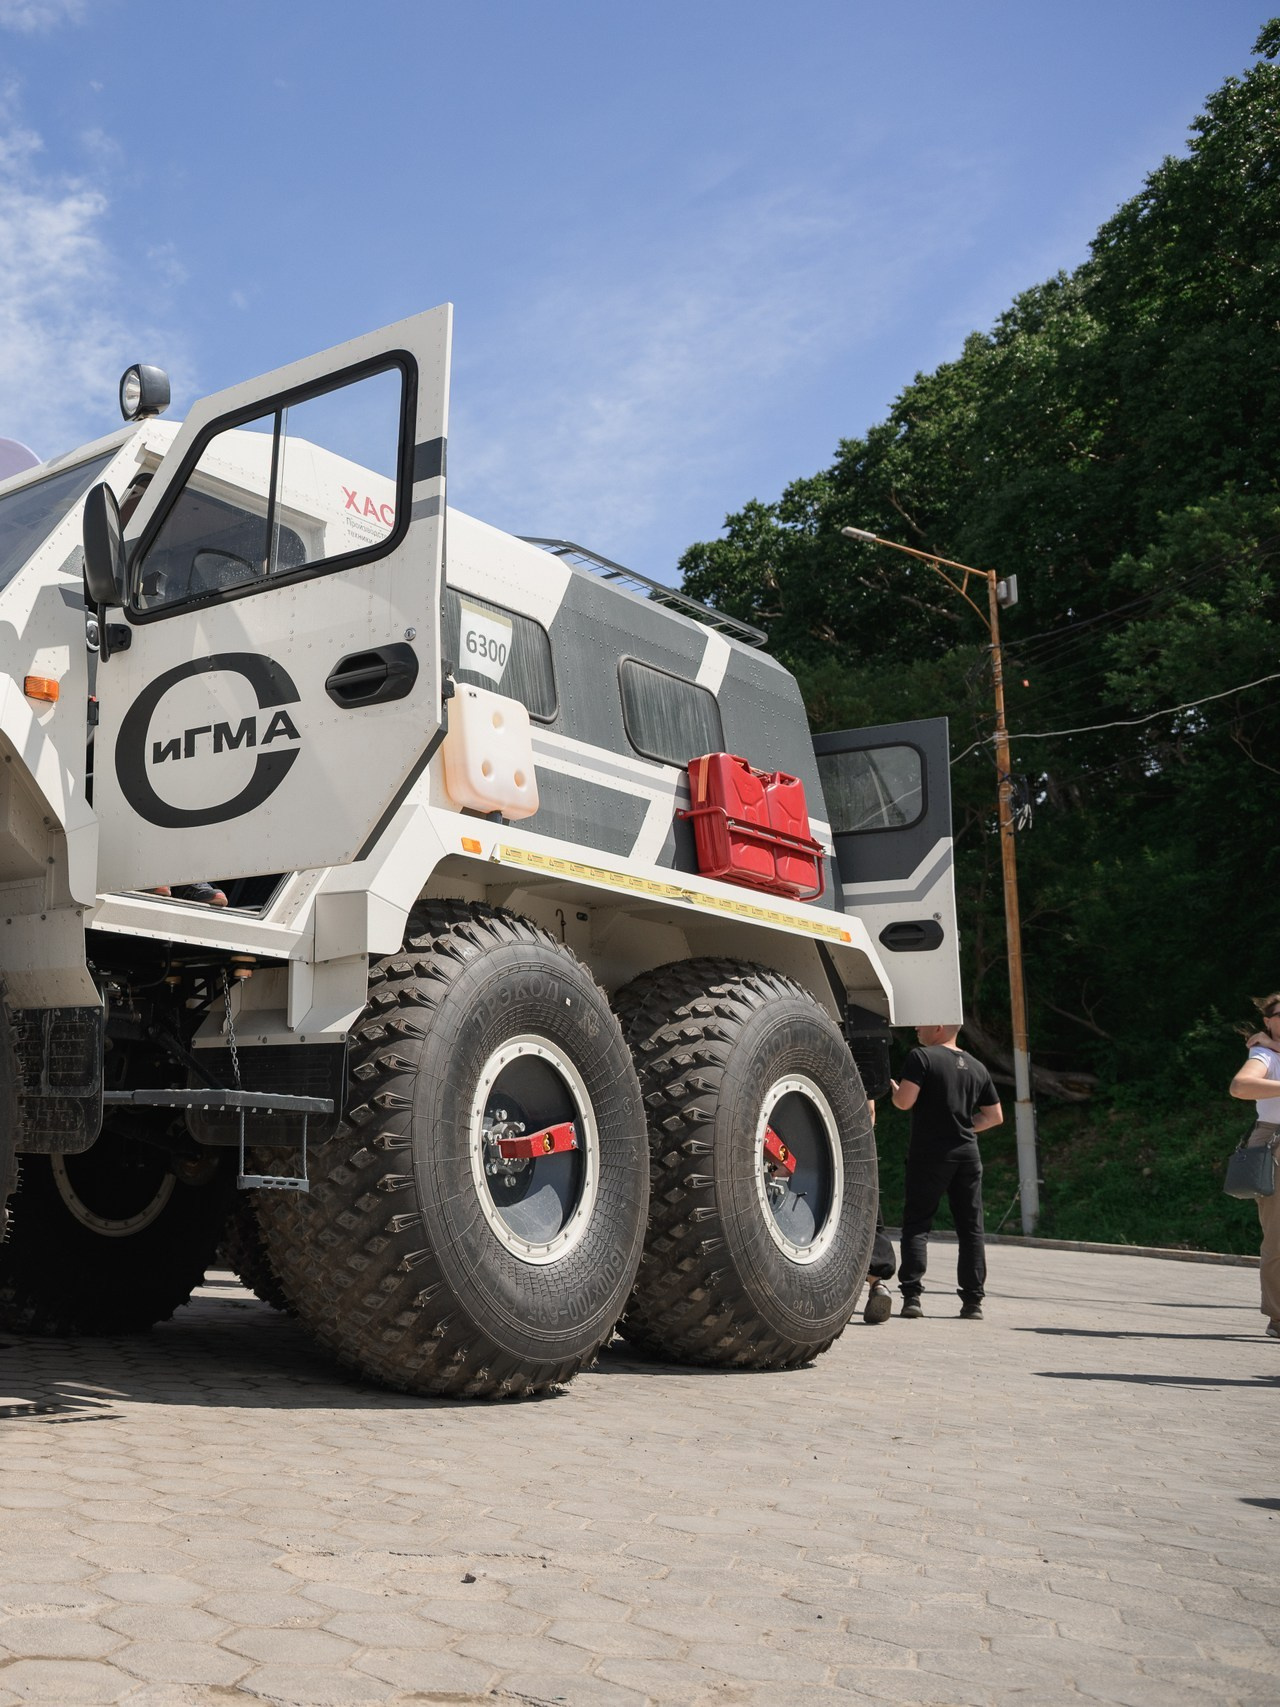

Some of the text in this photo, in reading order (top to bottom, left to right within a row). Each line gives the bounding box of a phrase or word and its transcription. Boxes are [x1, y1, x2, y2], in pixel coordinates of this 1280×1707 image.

[341, 485, 395, 528] ХАС
[466, 630, 506, 667] 6300
[471, 975, 561, 1032] ТРЭКОЛ
